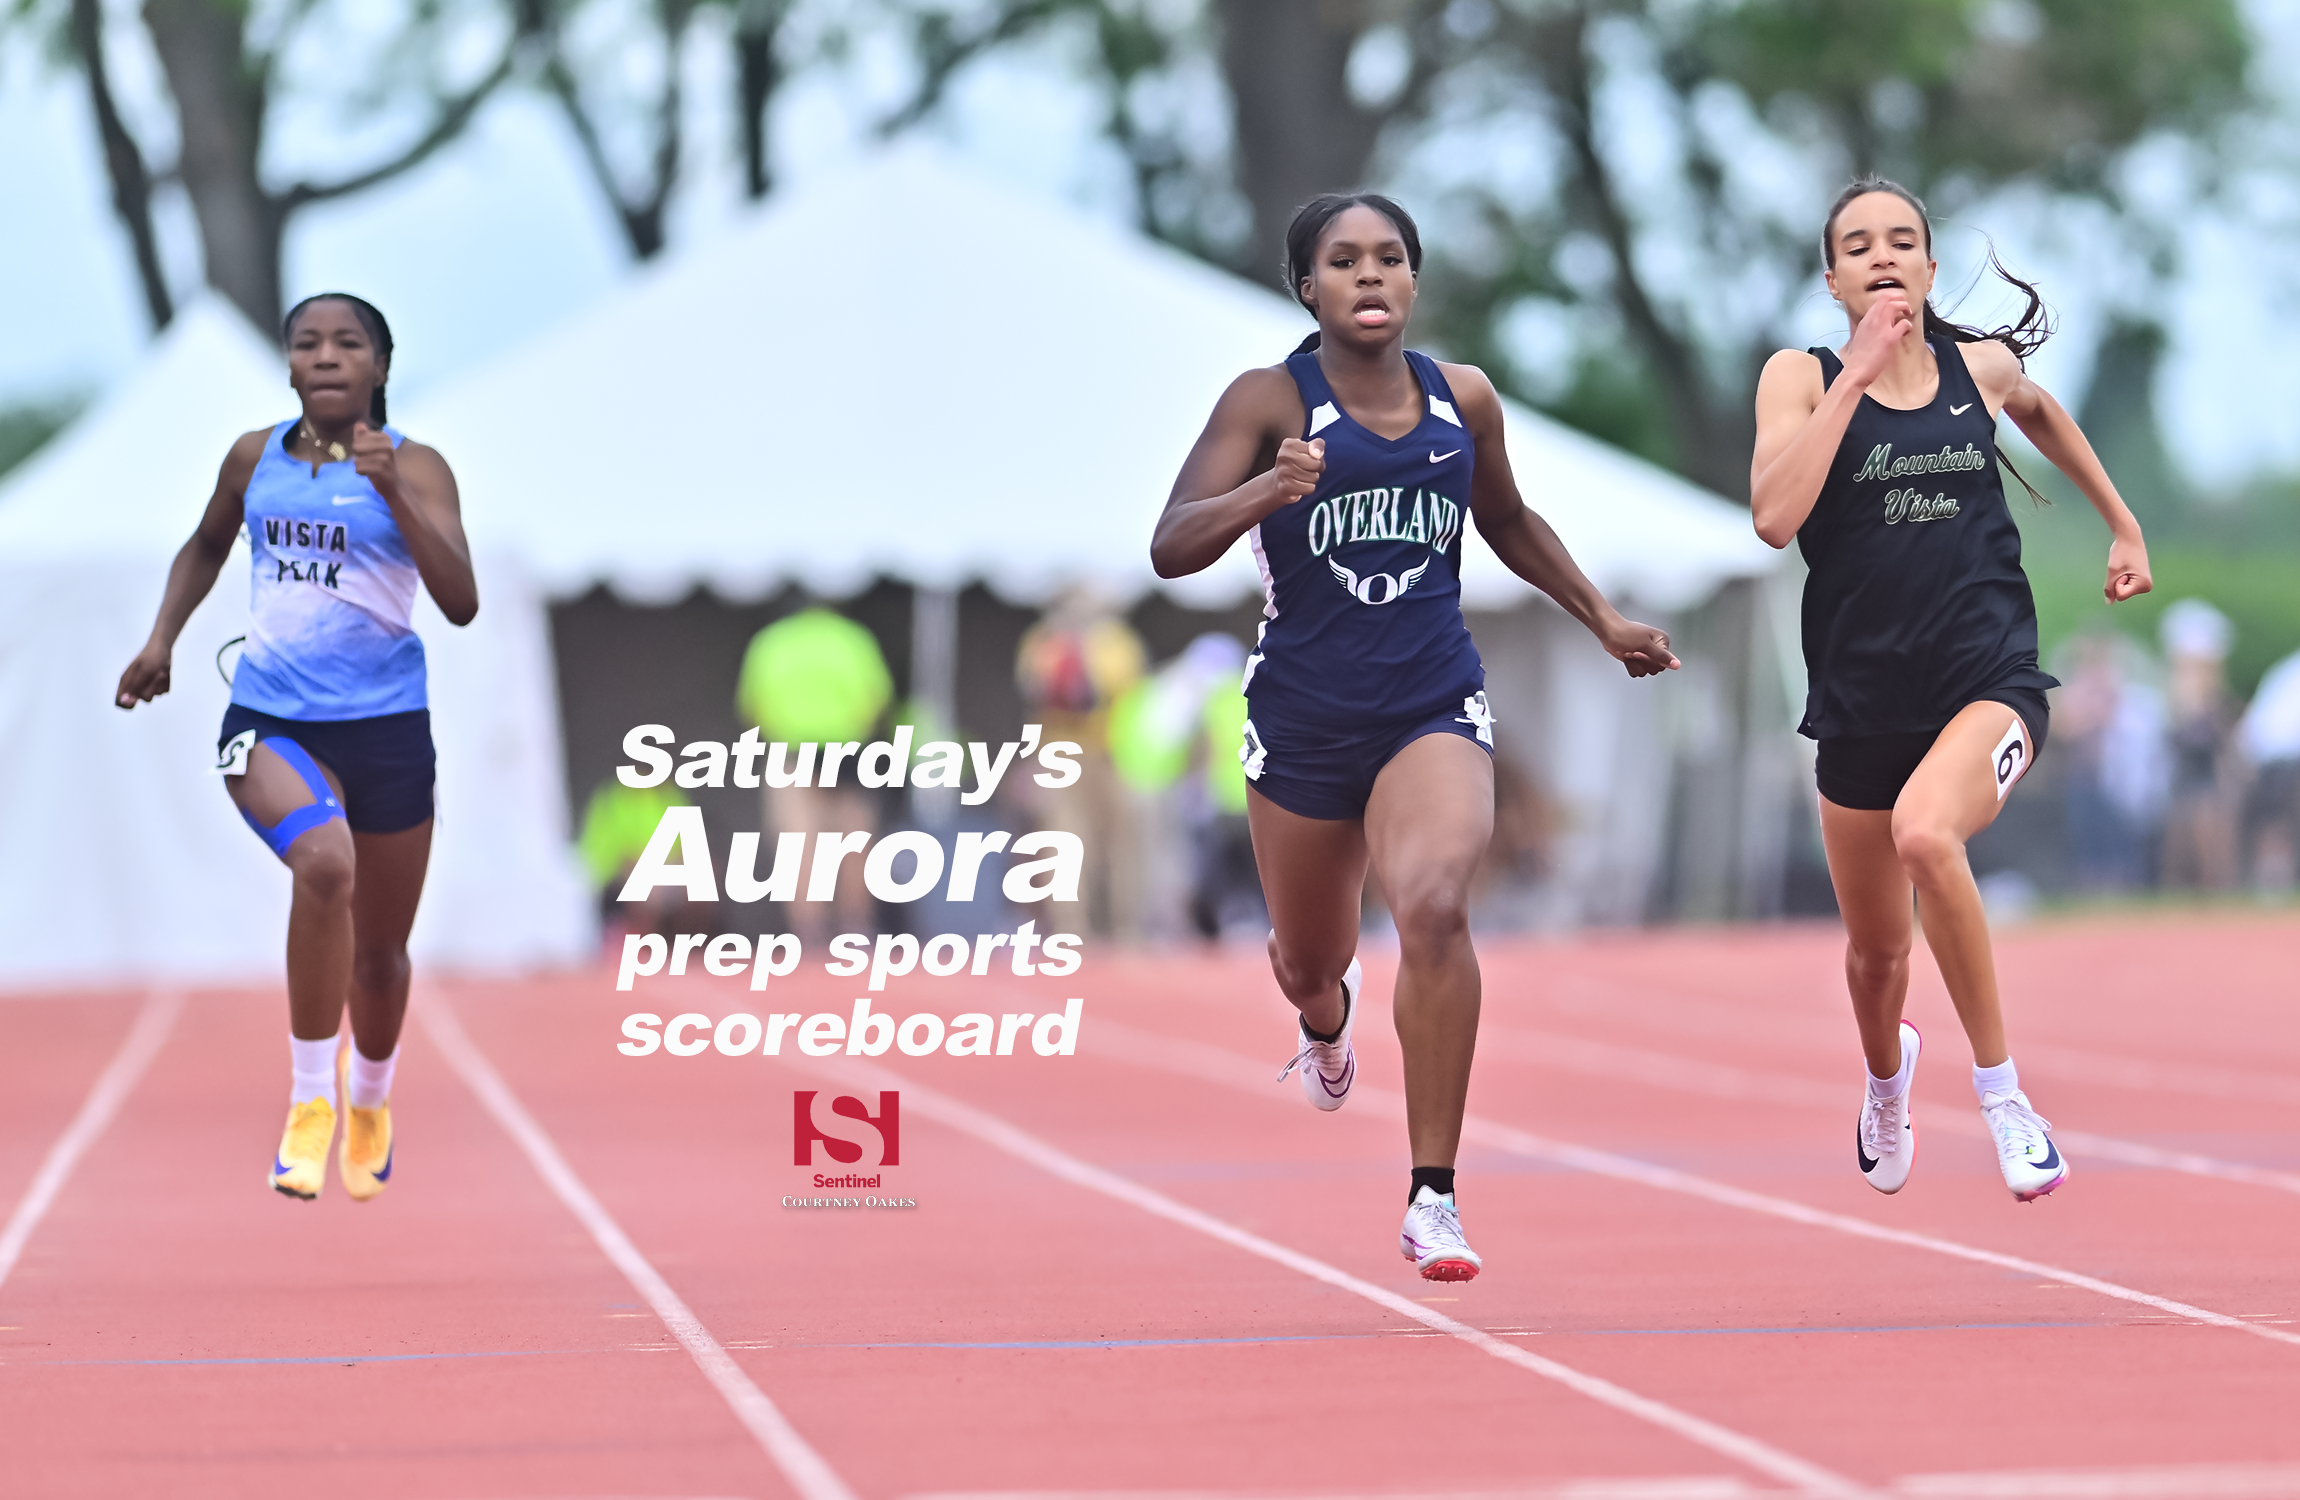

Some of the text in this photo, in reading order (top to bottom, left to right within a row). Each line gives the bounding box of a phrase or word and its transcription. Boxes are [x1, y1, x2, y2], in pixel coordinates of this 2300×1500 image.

[1853, 442, 1985, 482] Mountain
[1308, 486, 1460, 557] OVERLAND
[1884, 487, 1960, 525] Vista
[265, 519, 346, 553] VISTA
[277, 559, 343, 590] PEAK
[1997, 738, 2024, 784] 6
